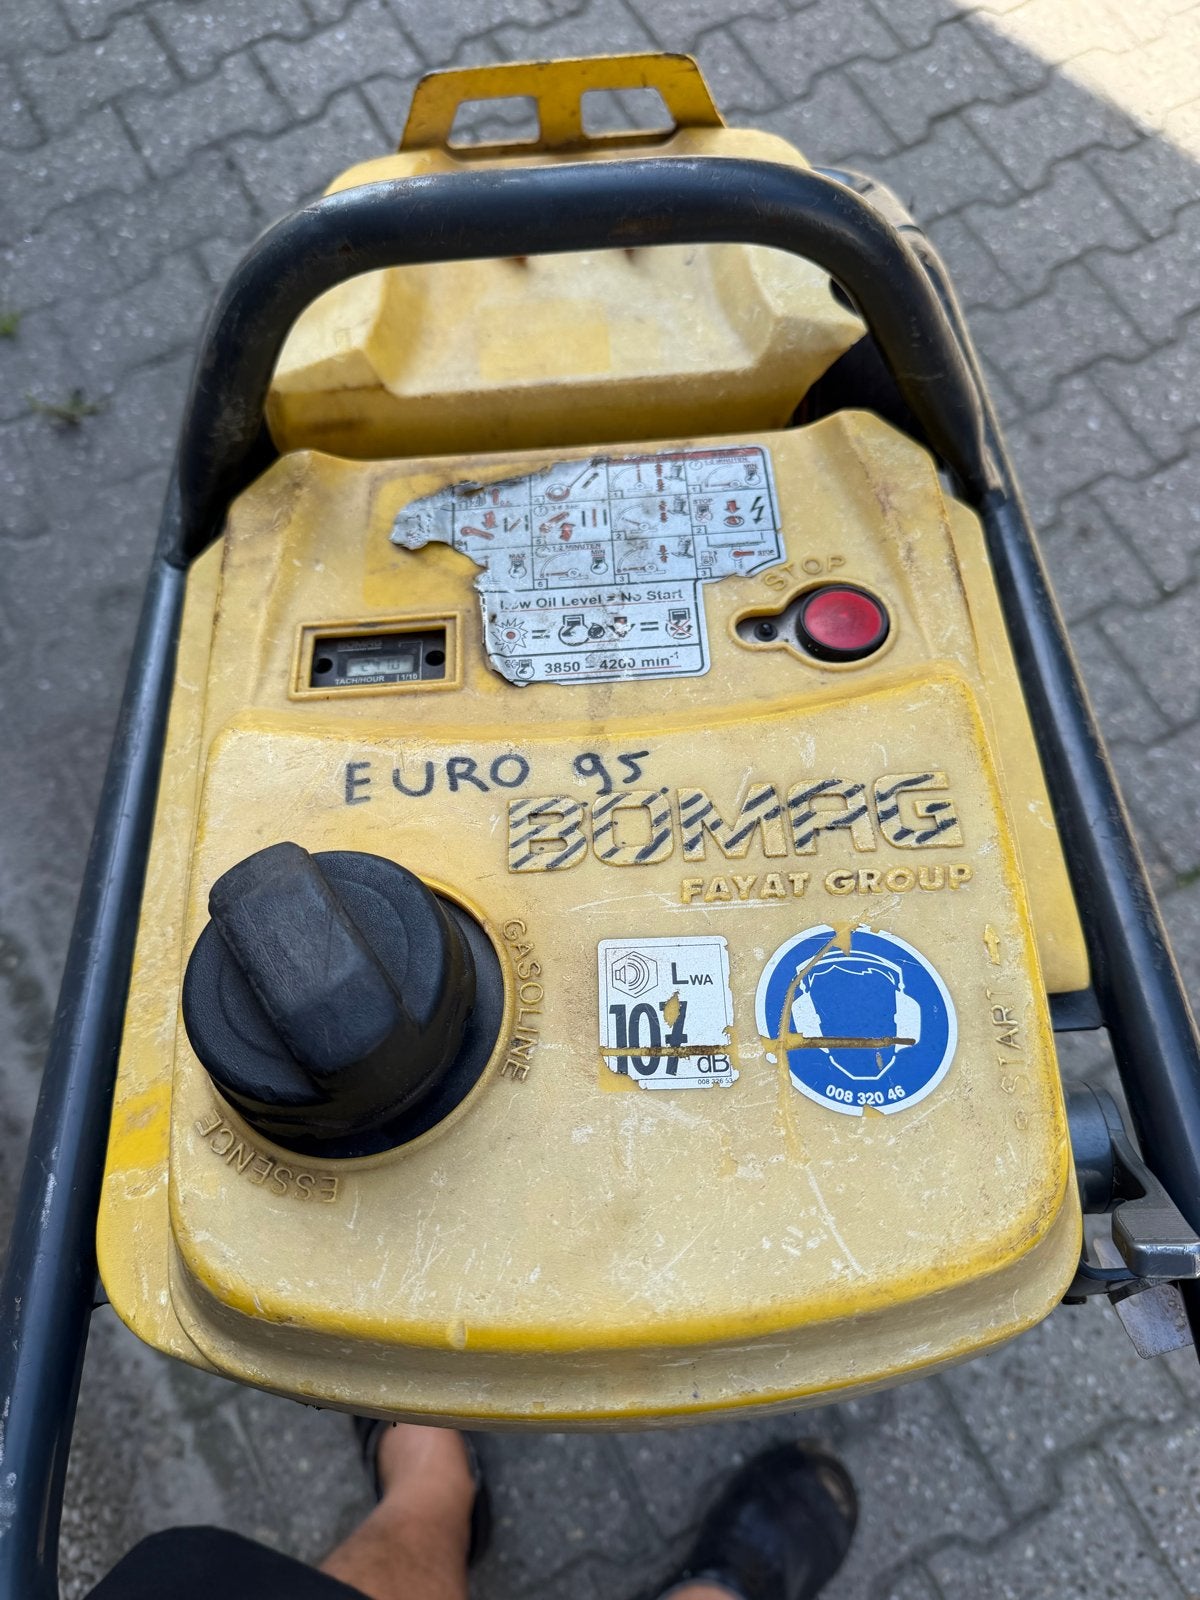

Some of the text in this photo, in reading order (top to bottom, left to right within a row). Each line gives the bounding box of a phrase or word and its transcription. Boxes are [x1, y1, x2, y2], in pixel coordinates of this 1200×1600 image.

[764, 555, 847, 591] STOP
[536, 597, 556, 608] Oil
[561, 594, 601, 607] Level
[621, 592, 642, 602] No
[646, 589, 684, 600] Start
[401, 673, 418, 681] 1/10
[544, 661, 581, 674] 3850
[599, 657, 636, 670] 4200
[345, 750, 650, 804] EURO 95
[507, 771, 967, 875] BOMAG
[680, 863, 974, 904] FAYAT GROUP
[500, 919, 545, 1083] GASOLINE
[609, 1001, 689, 1077] 107
[986, 986, 1028, 1096] START
[697, 1053, 731, 1074] dB
[826, 1084, 906, 1105] 008 320 46
[195, 1108, 341, 1204] ESSENCE
